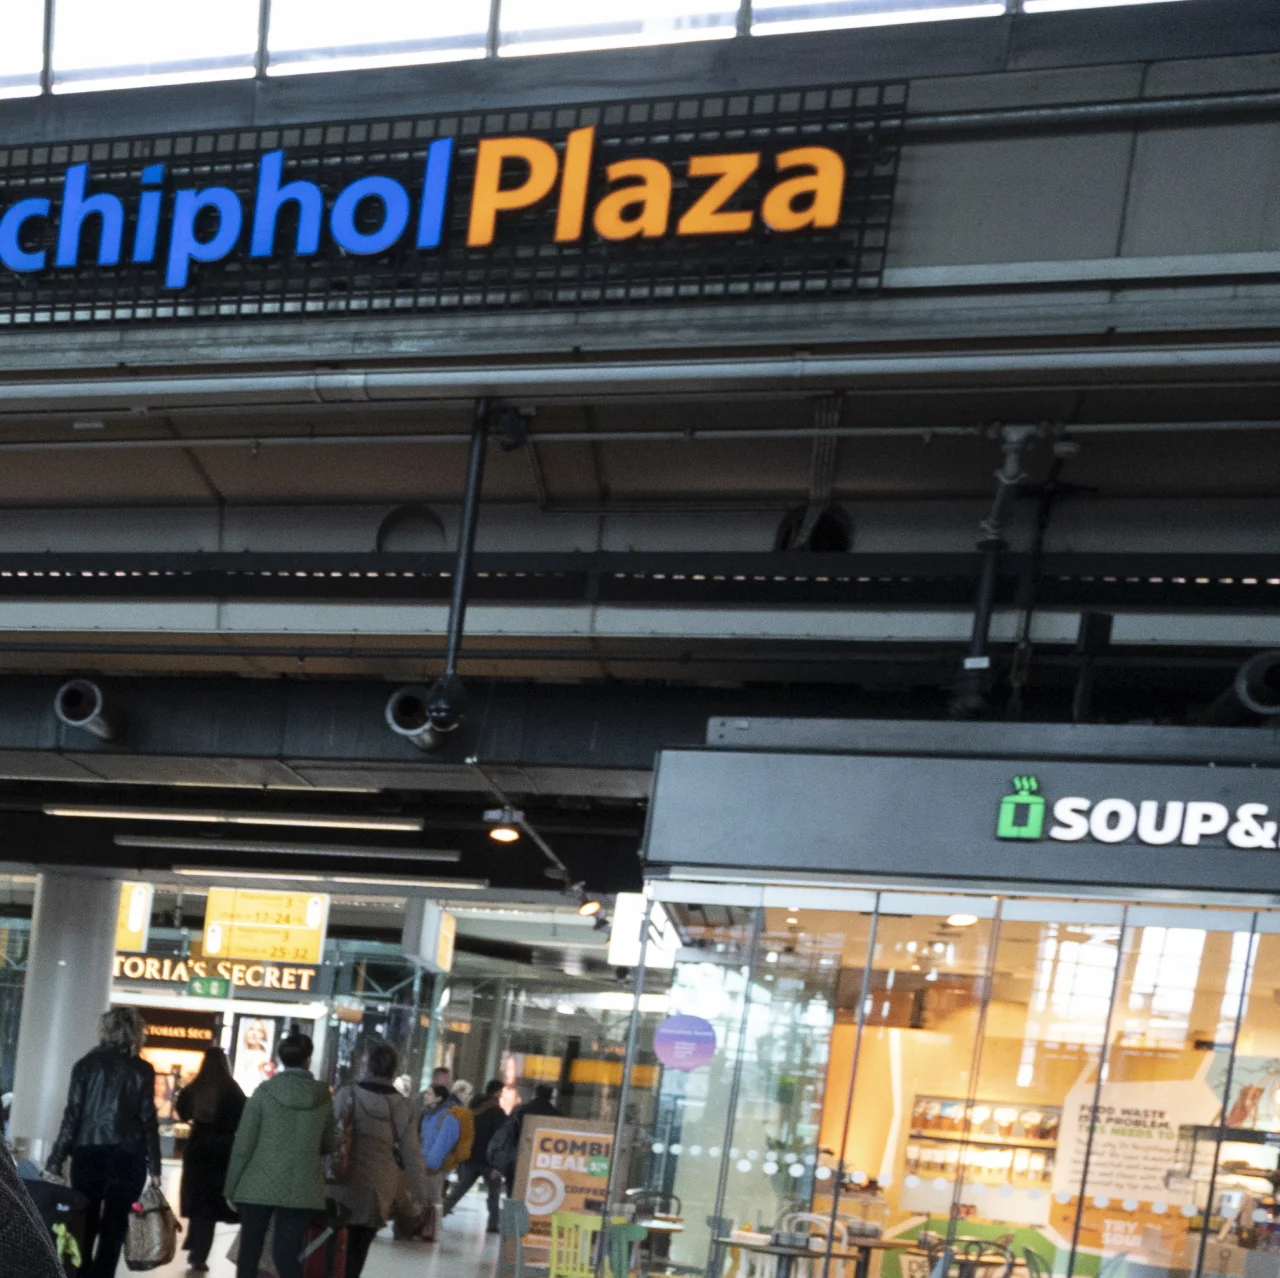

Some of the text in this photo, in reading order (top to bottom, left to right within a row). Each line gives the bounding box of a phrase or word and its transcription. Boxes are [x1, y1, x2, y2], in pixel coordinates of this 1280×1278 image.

[466, 127, 847, 247] Plaza
[217, 961, 316, 991] SECRET
[1121, 1107, 1166, 1118] WASTE
[540, 1138, 610, 1156] COMBI
[536, 1153, 588, 1173] DEAL
[1104, 1218, 1138, 1234] TRY
